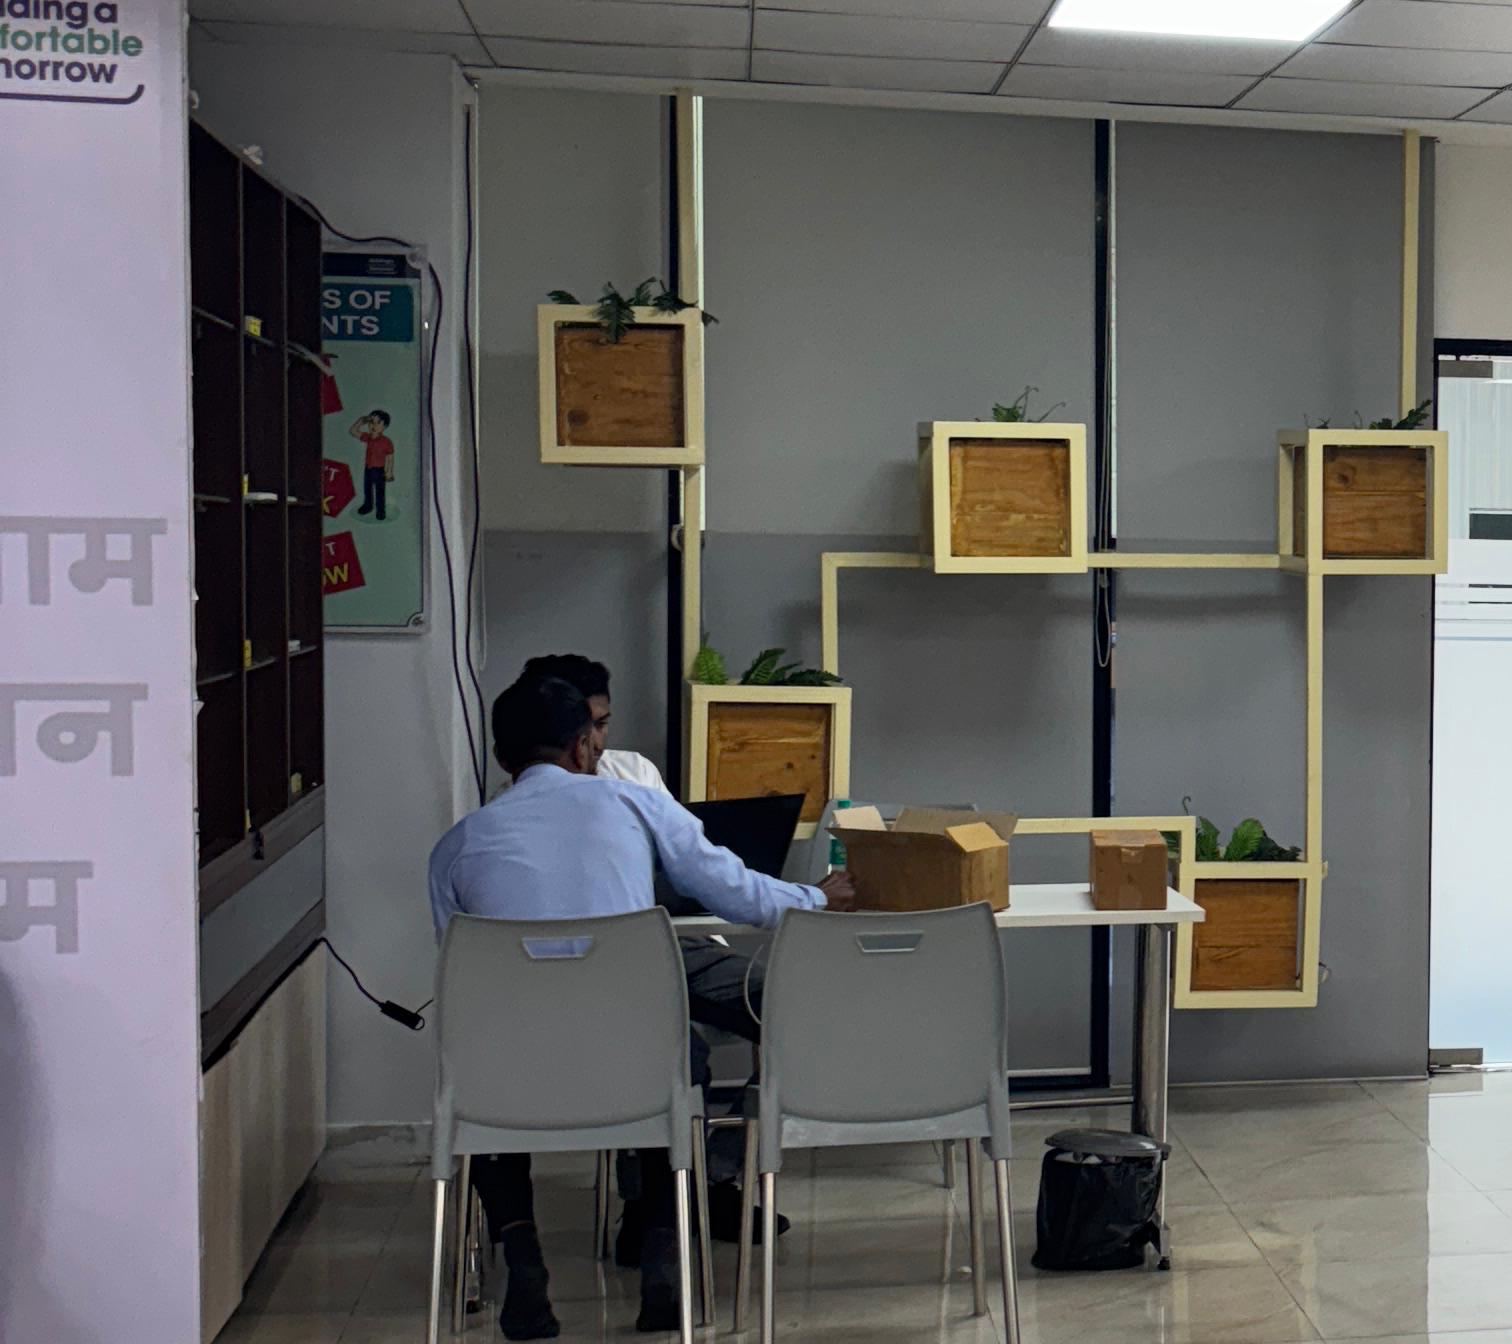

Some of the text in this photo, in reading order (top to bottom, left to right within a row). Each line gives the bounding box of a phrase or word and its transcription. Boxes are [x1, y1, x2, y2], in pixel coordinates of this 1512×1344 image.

[94, 2, 118, 24] a
[0, 23, 143, 57] fortable
[349, 289, 391, 310] OF
